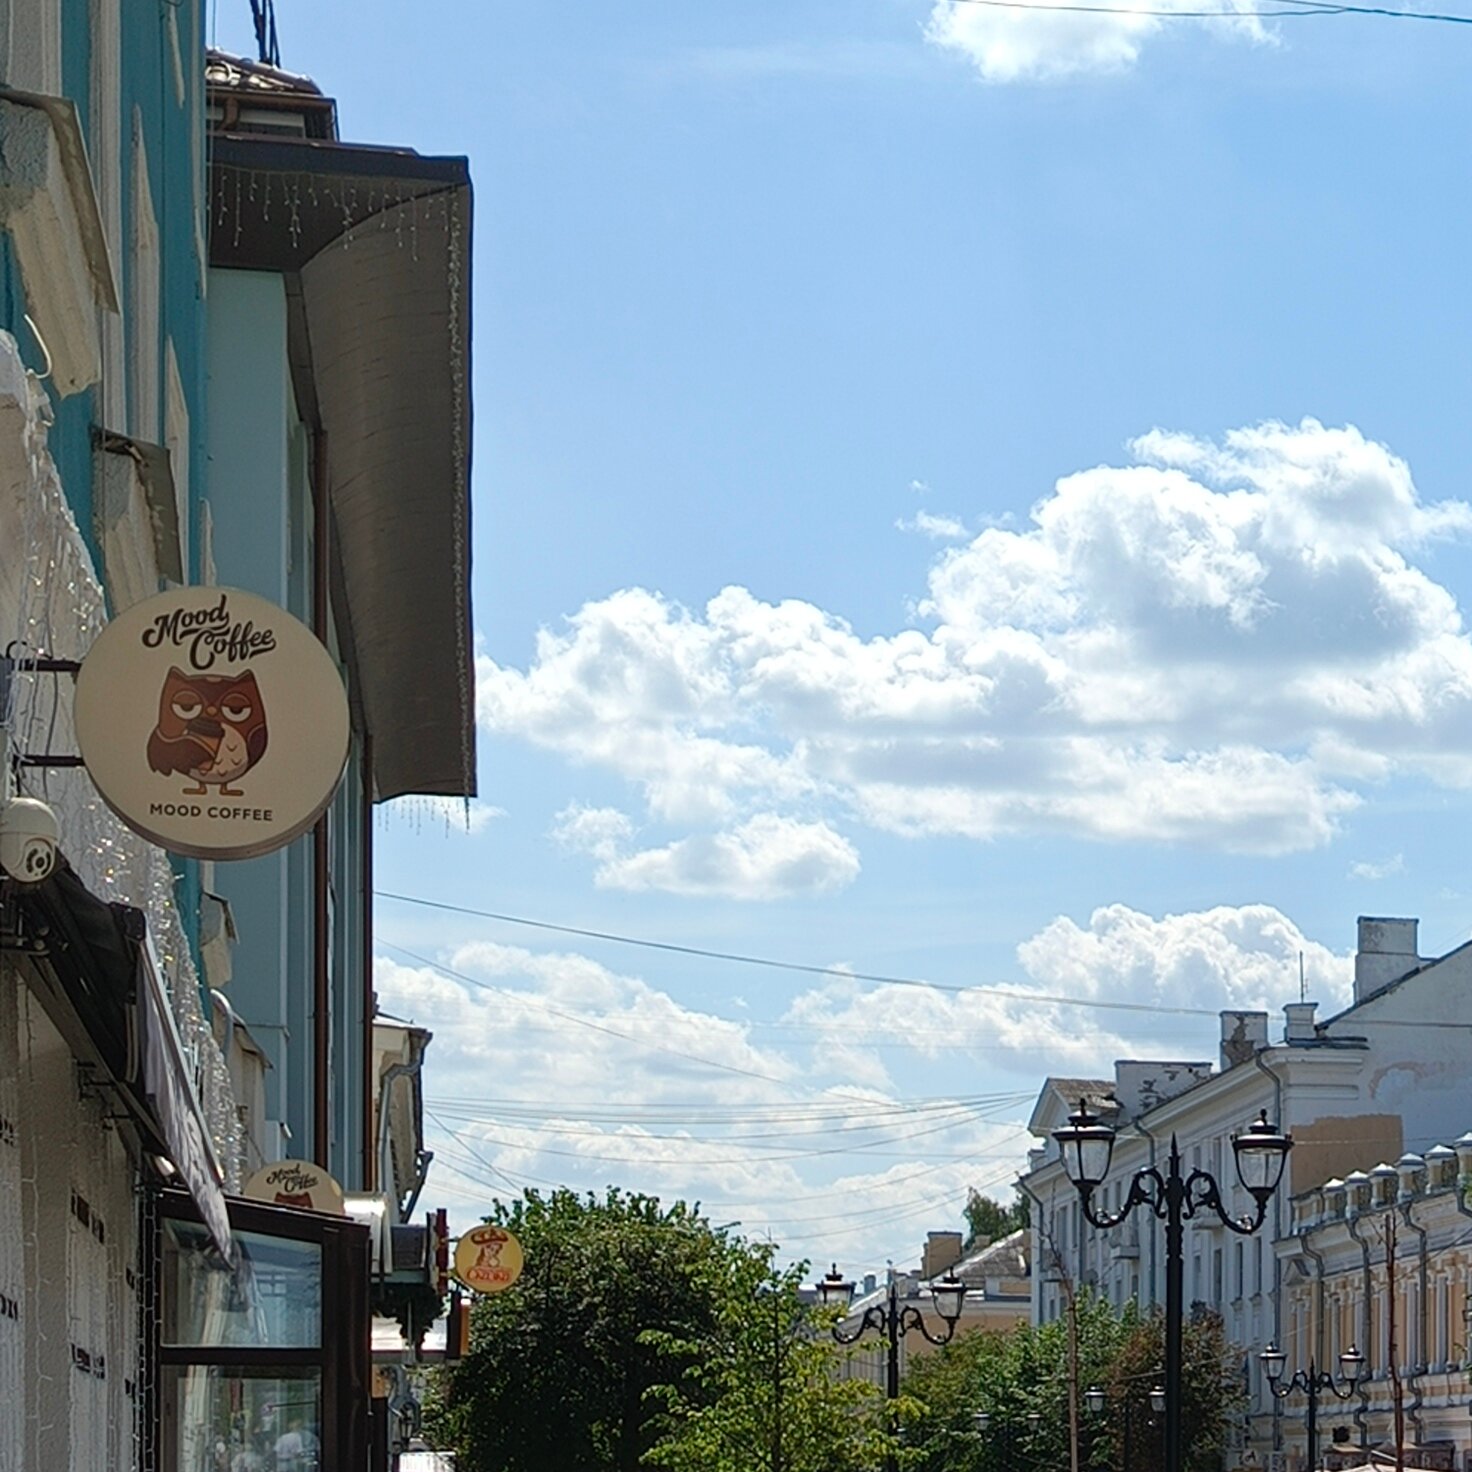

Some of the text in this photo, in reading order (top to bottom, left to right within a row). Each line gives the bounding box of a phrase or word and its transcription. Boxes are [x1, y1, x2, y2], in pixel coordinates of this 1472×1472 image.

[142, 593, 229, 648] Mood
[190, 620, 277, 670] Coffee
[150, 803, 274, 822] MOOD COFFEE
[266, 1163, 302, 1185] Mood
